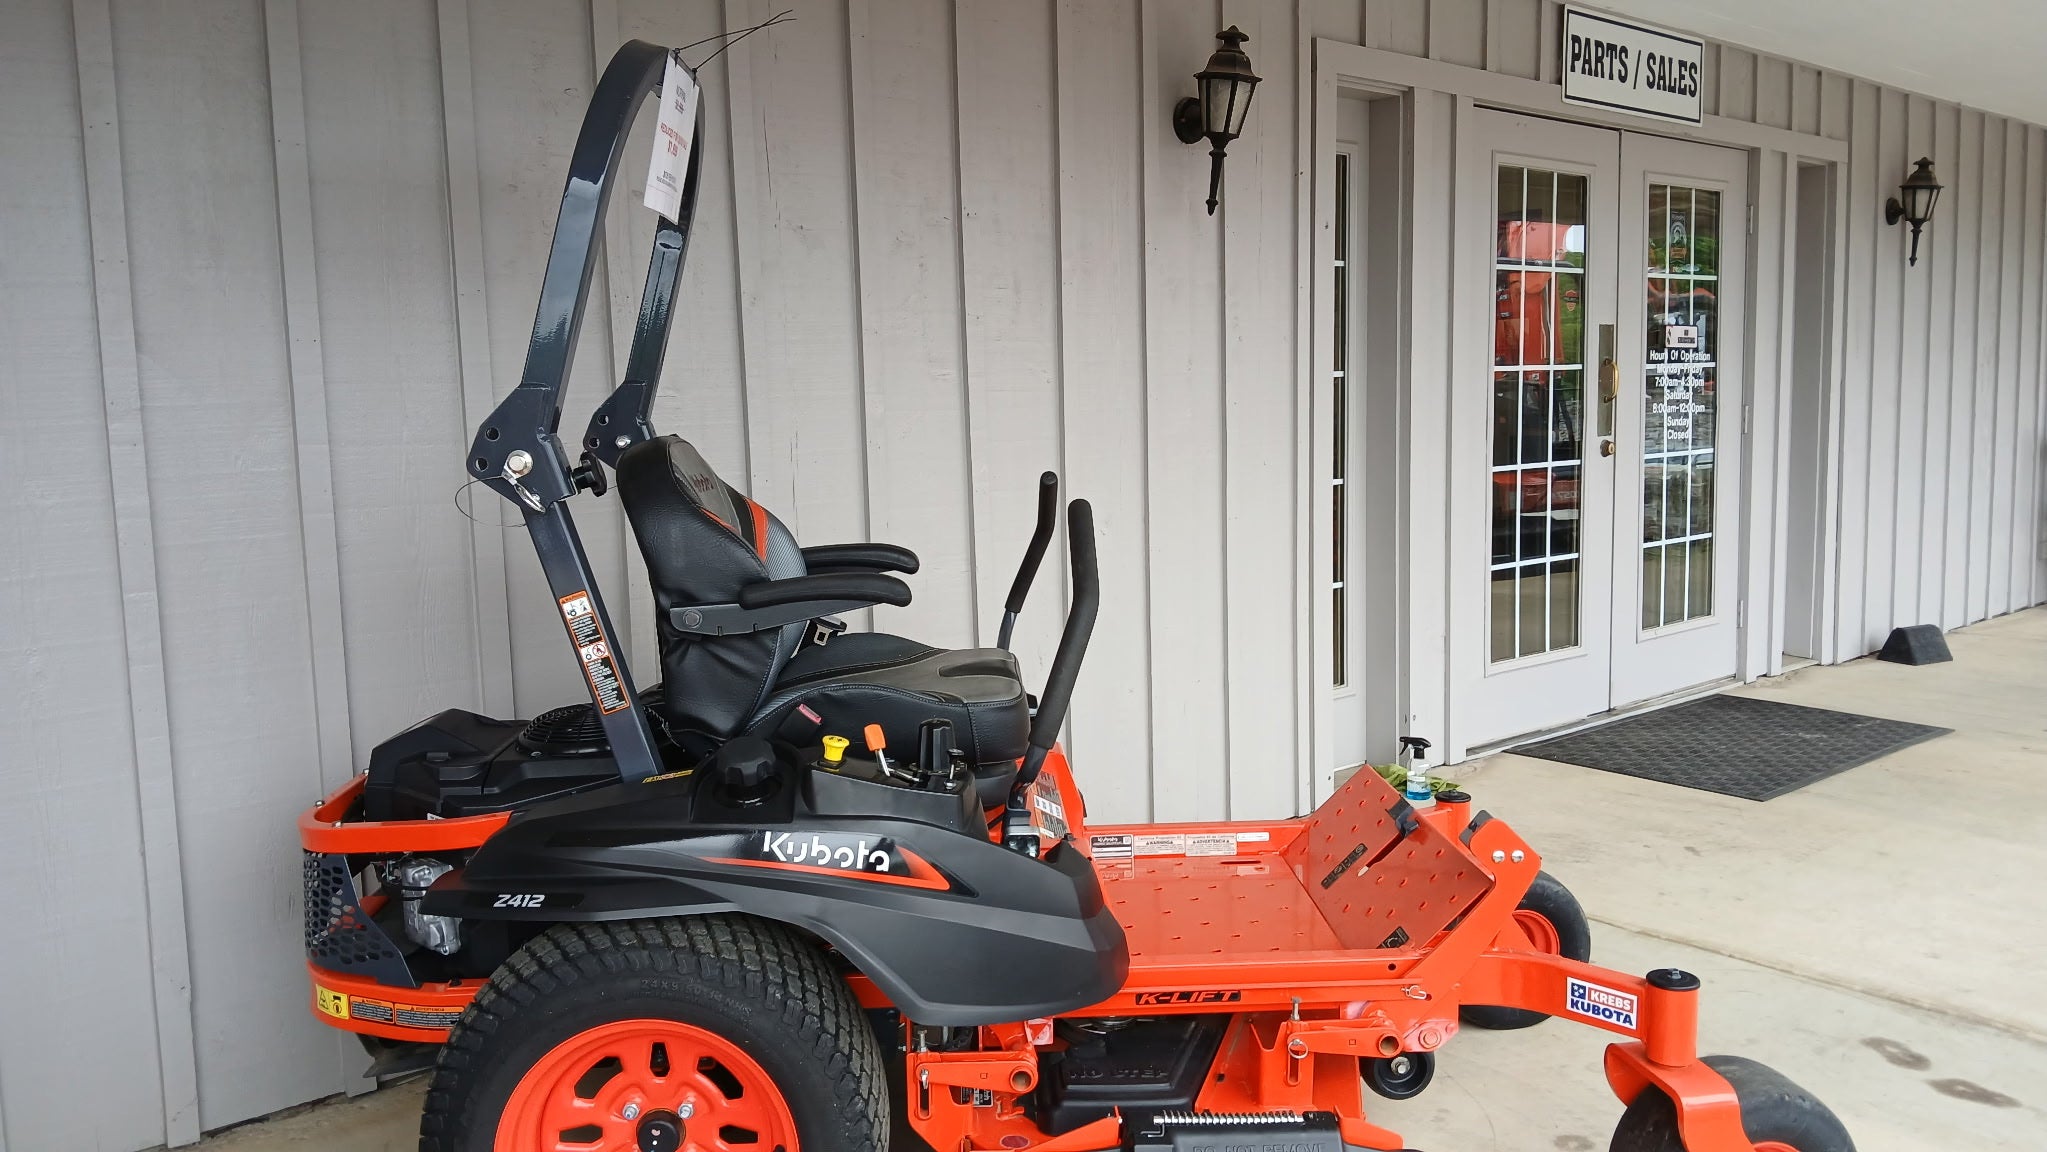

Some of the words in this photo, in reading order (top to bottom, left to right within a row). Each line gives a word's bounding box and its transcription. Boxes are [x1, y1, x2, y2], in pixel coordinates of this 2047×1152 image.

[1570, 34, 1629, 83] PARTS
[1633, 50, 1641, 89] /
[1646, 52, 1697, 97] SALES
[1671, 350, 1678, 360] Of
[1665, 389, 1693, 400] Saturday
[1667, 416, 1690, 428] Sunday
[1667, 429, 1689, 440] Closed
[763, 831, 890, 872] Kubota
[493, 894, 545, 907] Z412
[1139, 991, 1239, 1005] K-LIFT
[1590, 990, 1631, 1011] KREBS
[1571, 998, 1633, 1027] KUBOTA
